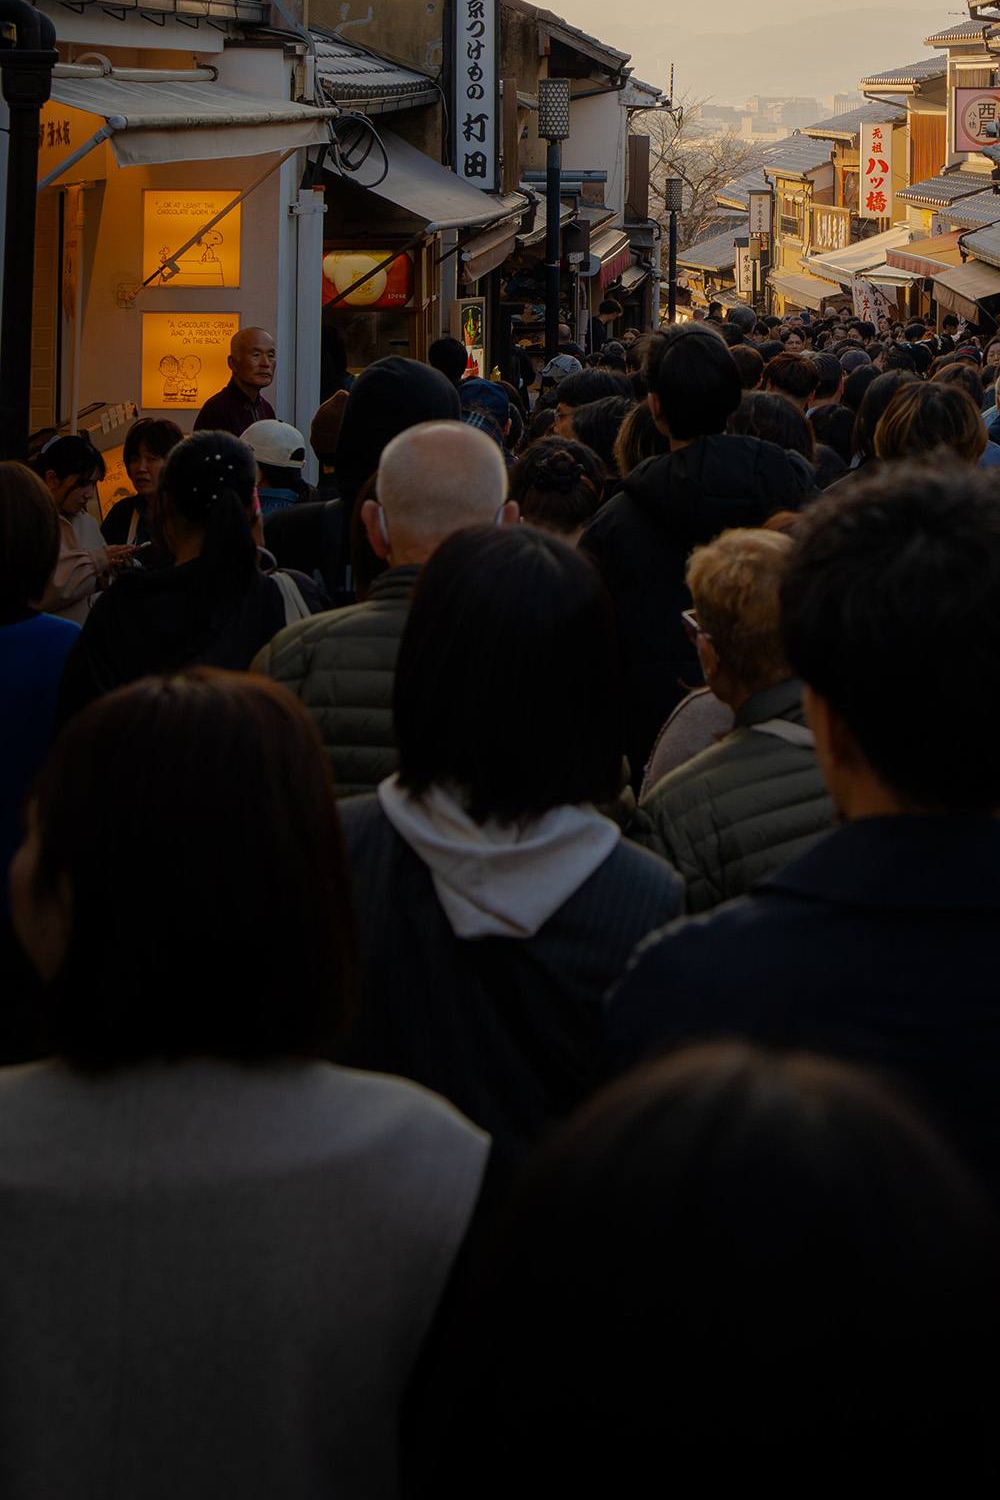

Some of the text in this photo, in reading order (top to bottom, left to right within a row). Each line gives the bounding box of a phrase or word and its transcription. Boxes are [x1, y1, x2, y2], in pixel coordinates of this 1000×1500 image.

[871, 127, 883, 153] 元祖
[462, 112, 489, 179] 打田
[174, 201, 181, 209] AT
[182, 201, 201, 209] LEAST
[171, 329, 233, 337] AND A FRIENDLY PAT
[182, 337, 191, 345] ON
[192, 337, 203, 345] THE
